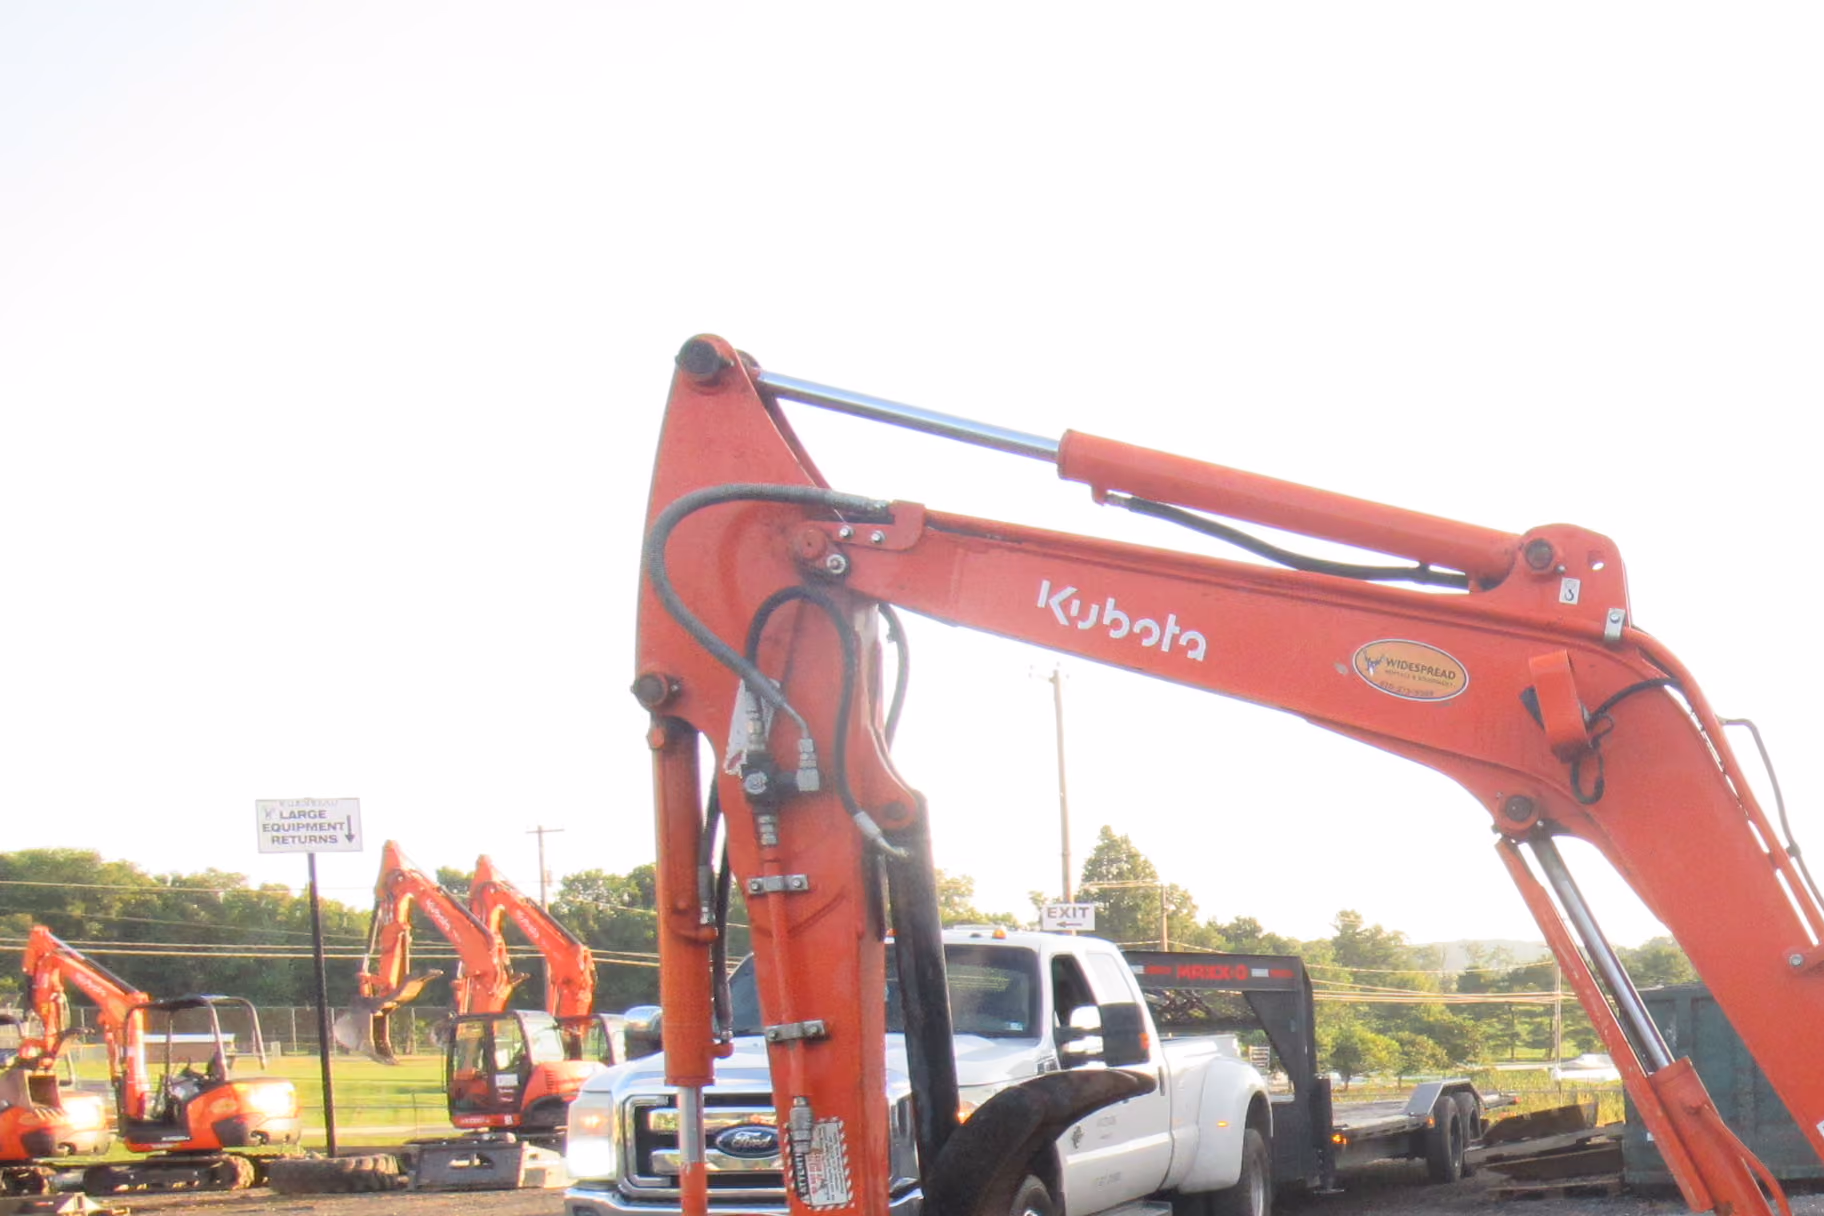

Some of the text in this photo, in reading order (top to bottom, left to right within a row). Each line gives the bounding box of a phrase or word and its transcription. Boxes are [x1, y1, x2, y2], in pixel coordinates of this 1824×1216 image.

[1037, 580, 1207, 661] Kubota
[1386, 658, 1456, 680] WIDESPREAD
[279, 810, 327, 819] LARGE
[262, 822, 345, 832] EQUIPMENT
[271, 835, 338, 844] RETURNS
[1047, 906, 1090, 919] EXIT
[731, 1131, 773, 1148] Ford
